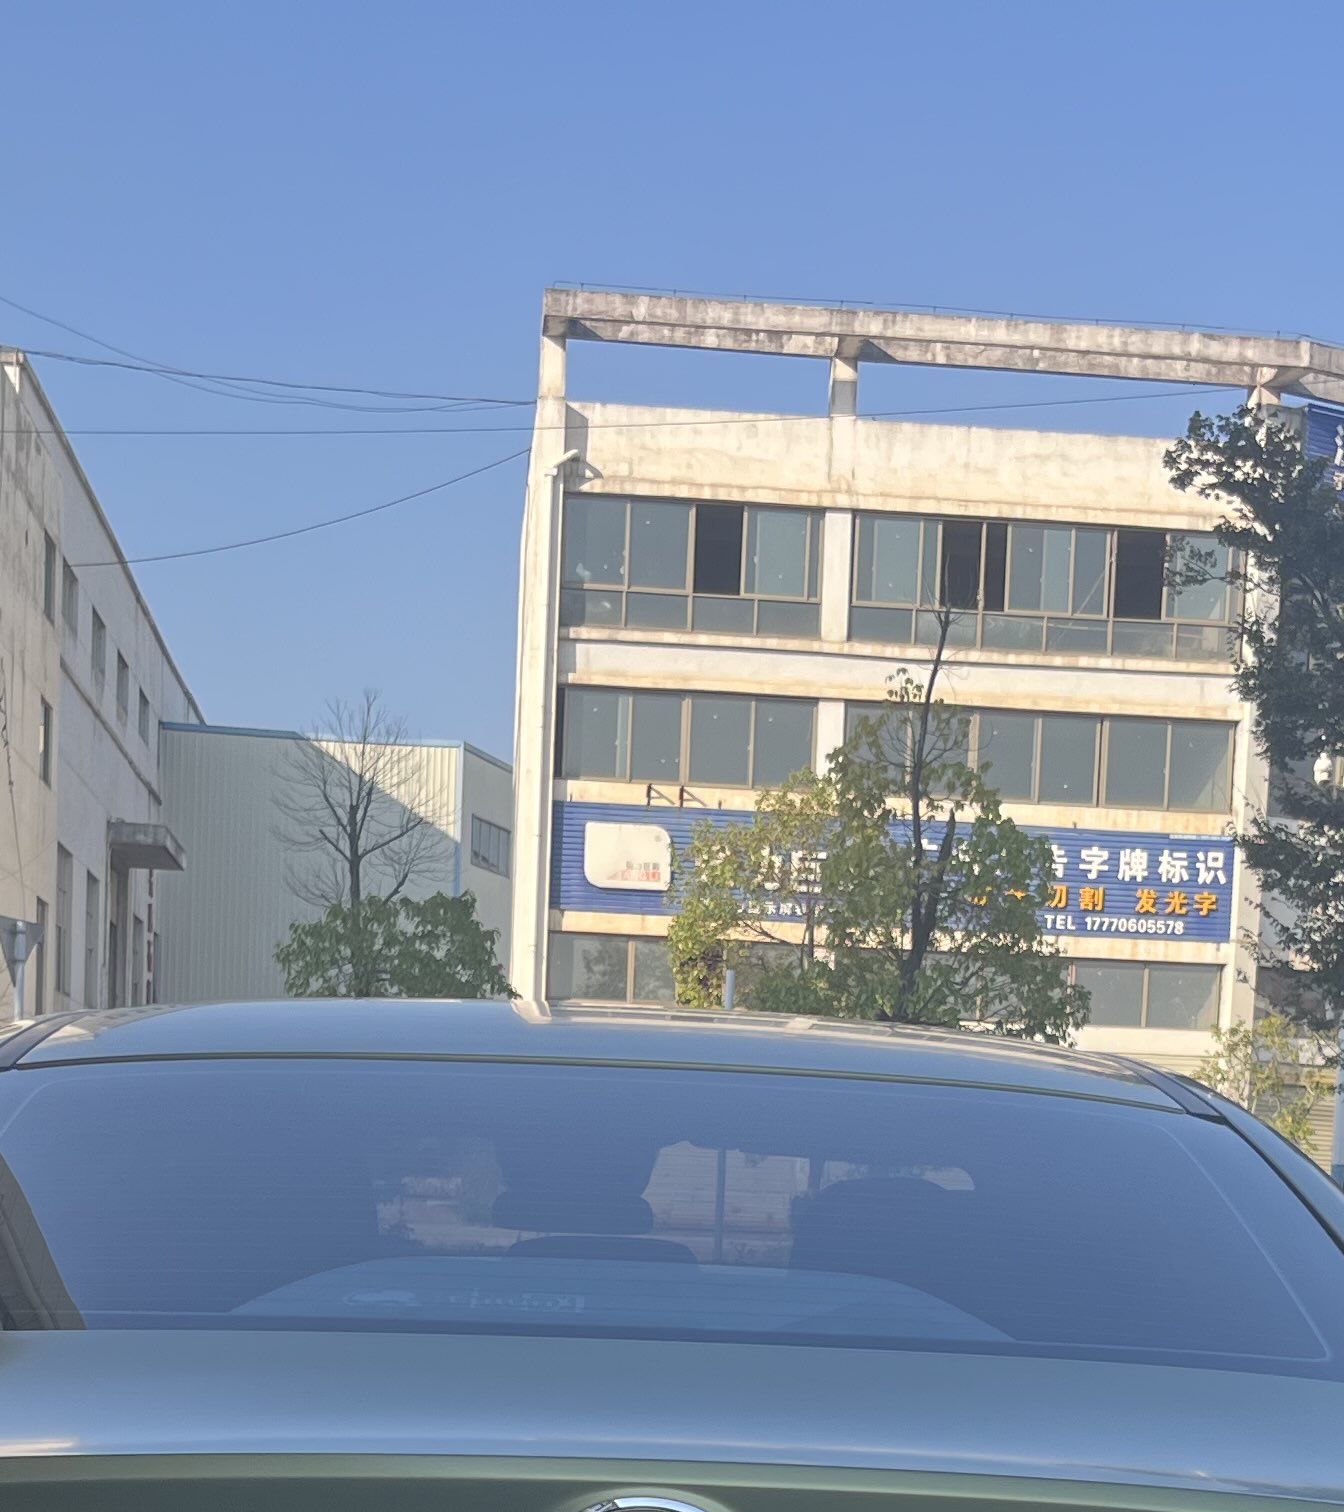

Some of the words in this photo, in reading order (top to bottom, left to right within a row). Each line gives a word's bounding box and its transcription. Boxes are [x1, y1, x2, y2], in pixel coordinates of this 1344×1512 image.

[1134, 888, 1218, 917] 发光字
[1044, 914, 1076, 931] TEL
[1084, 915, 1185, 936] 17770605578
